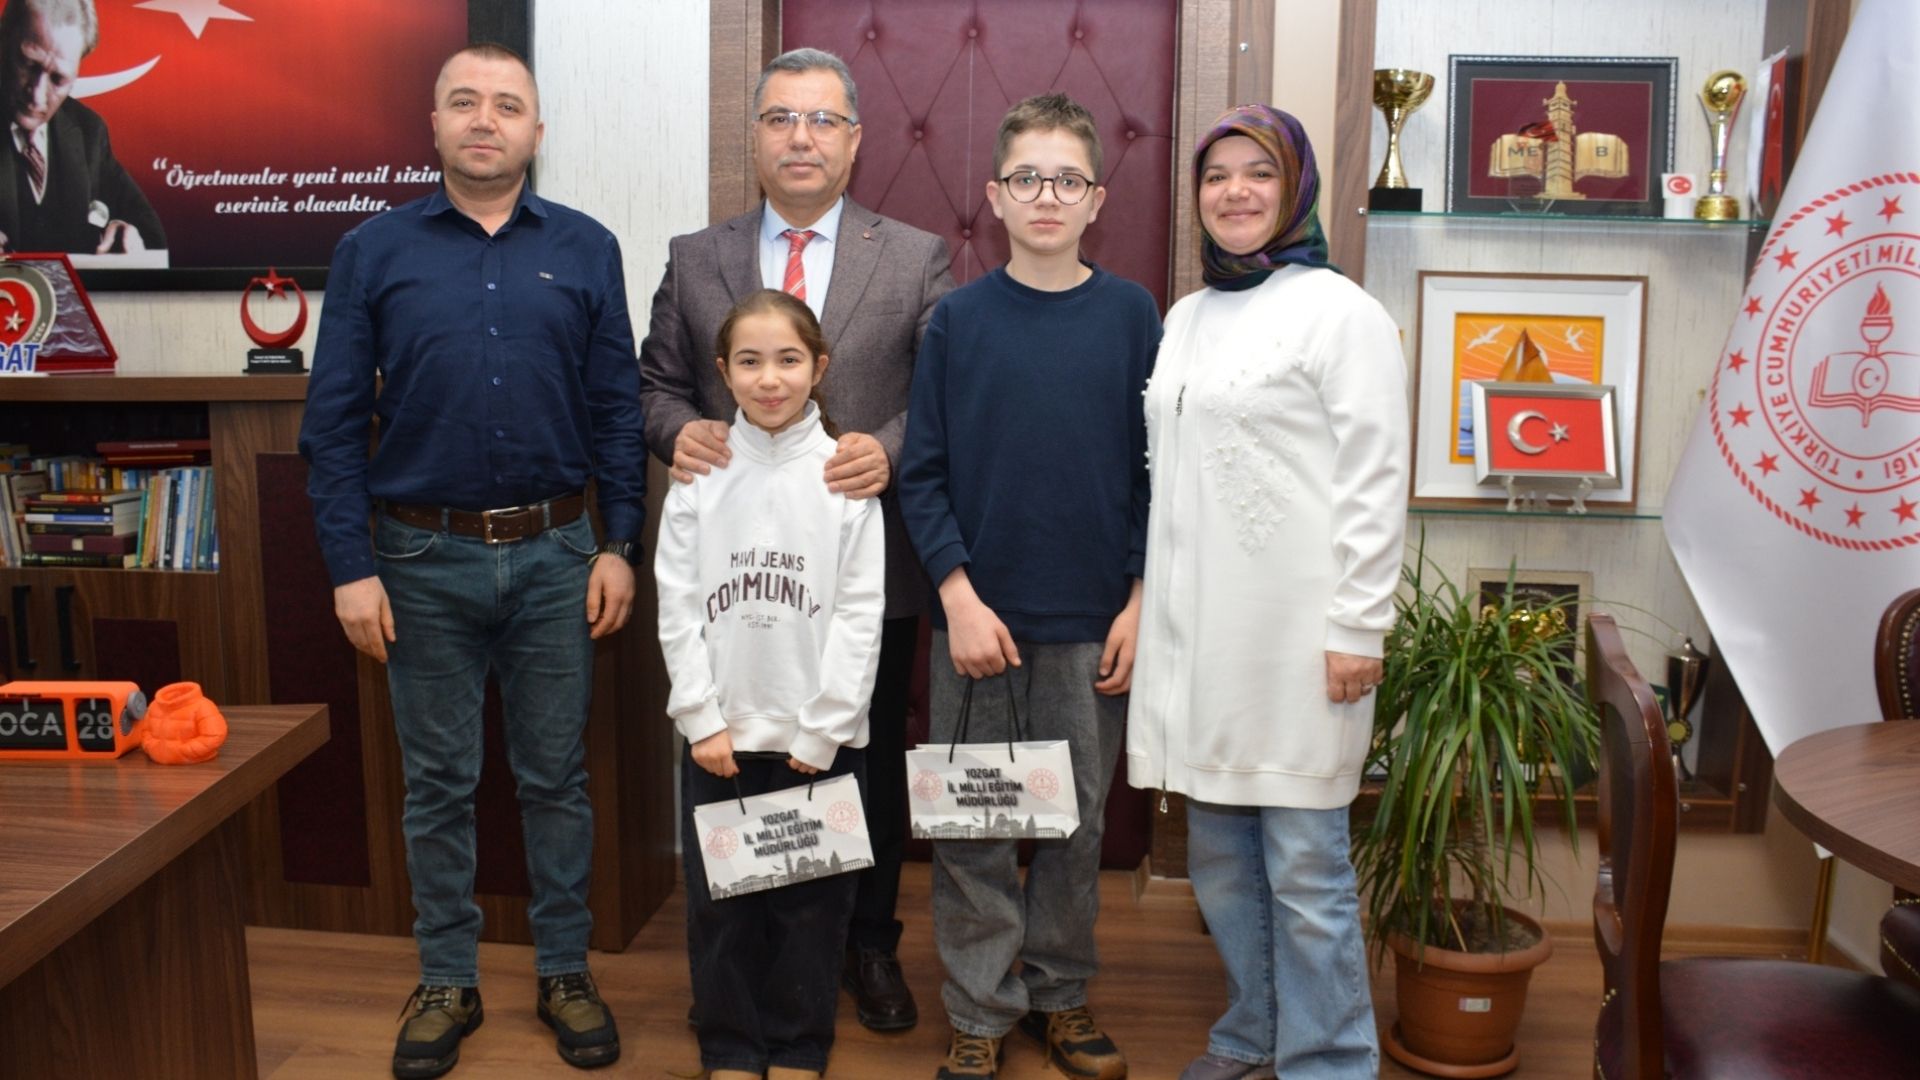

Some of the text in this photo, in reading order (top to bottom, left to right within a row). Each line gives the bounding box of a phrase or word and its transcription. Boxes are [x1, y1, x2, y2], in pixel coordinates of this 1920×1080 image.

[1596, 146, 1608, 157] B
[292, 167, 336, 188] yeni
[341, 165, 390, 185] nesil
[393, 165, 442, 185] sizin
[215, 193, 393, 214] eseriniz olacaktır.
[1767, 240, 1920, 478] TÜRKİYE CUMHURİYETİ MİL
[760, 551, 805, 572] JEANS
[705, 571, 821, 624] COMMUNIY
[0, 712, 114, 739] OCA 28
[964, 768, 1002, 779] YOZGAT
[947, 780, 957, 793] İL
[988, 780, 1024, 793] EĞİTİM
[956, 793, 1019, 808] MÜDÜRLÜĞÜ
[760, 809, 800, 826] YOZGAT
[743, 831, 754, 845] İL
[788, 819, 824, 836] EĞİTİM
[754, 831, 819, 859] MÜDÜRLÜĞÜ
